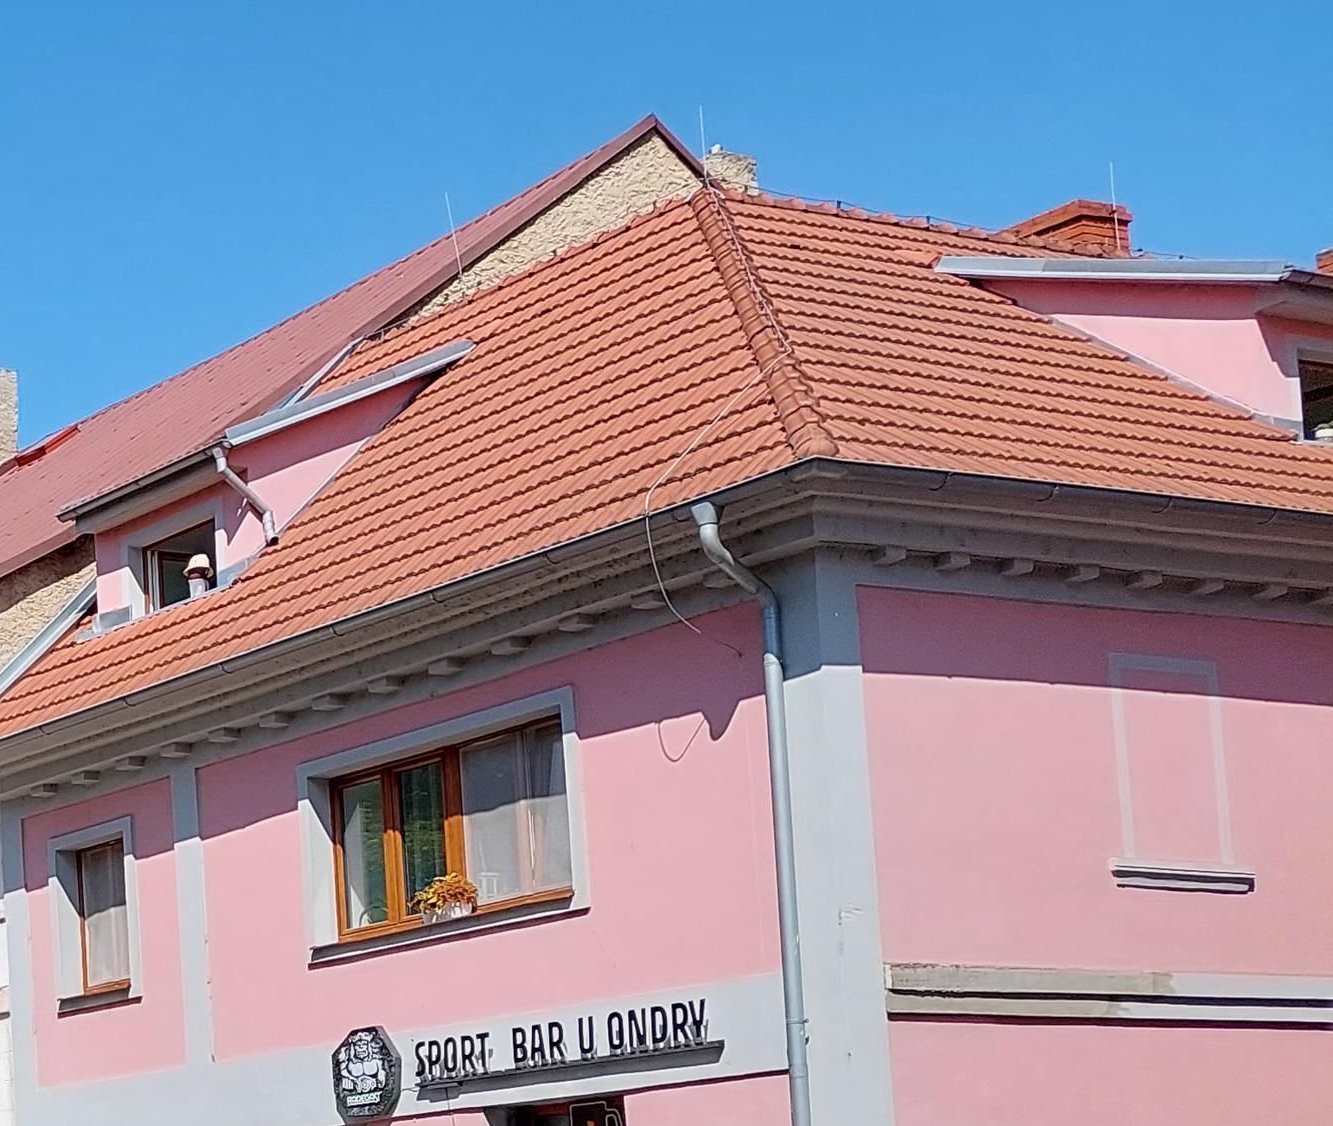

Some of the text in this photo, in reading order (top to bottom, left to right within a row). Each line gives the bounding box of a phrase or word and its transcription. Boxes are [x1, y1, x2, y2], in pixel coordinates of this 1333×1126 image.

[415, 998, 707, 1078] SPORT BAR U ONDRY
